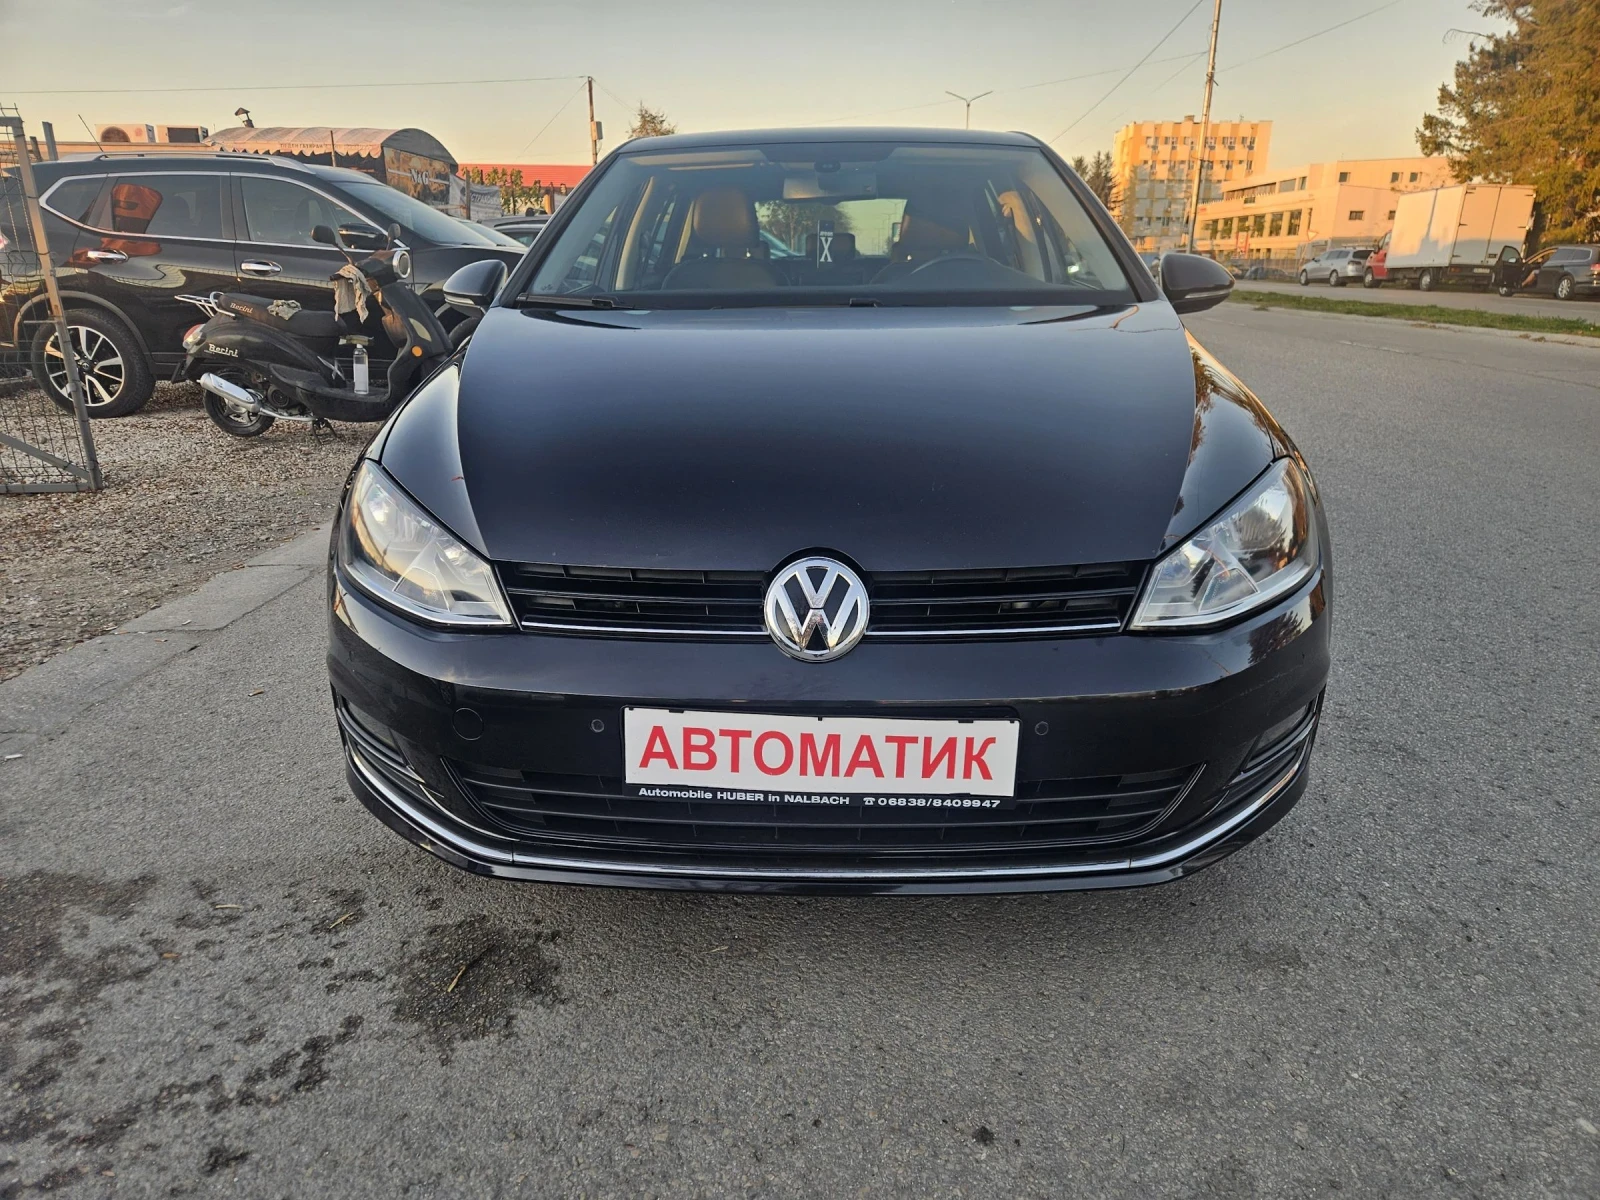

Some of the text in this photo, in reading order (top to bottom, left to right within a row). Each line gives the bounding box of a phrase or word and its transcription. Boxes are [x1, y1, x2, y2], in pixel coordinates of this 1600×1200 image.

[230, 302, 254, 314] Berini
[208, 343, 239, 358] Berini
[638, 725, 997, 781] АВТОМАТИК
[638, 787, 1001, 808] Automobile HUBER in NALBACH 06838/8409947
